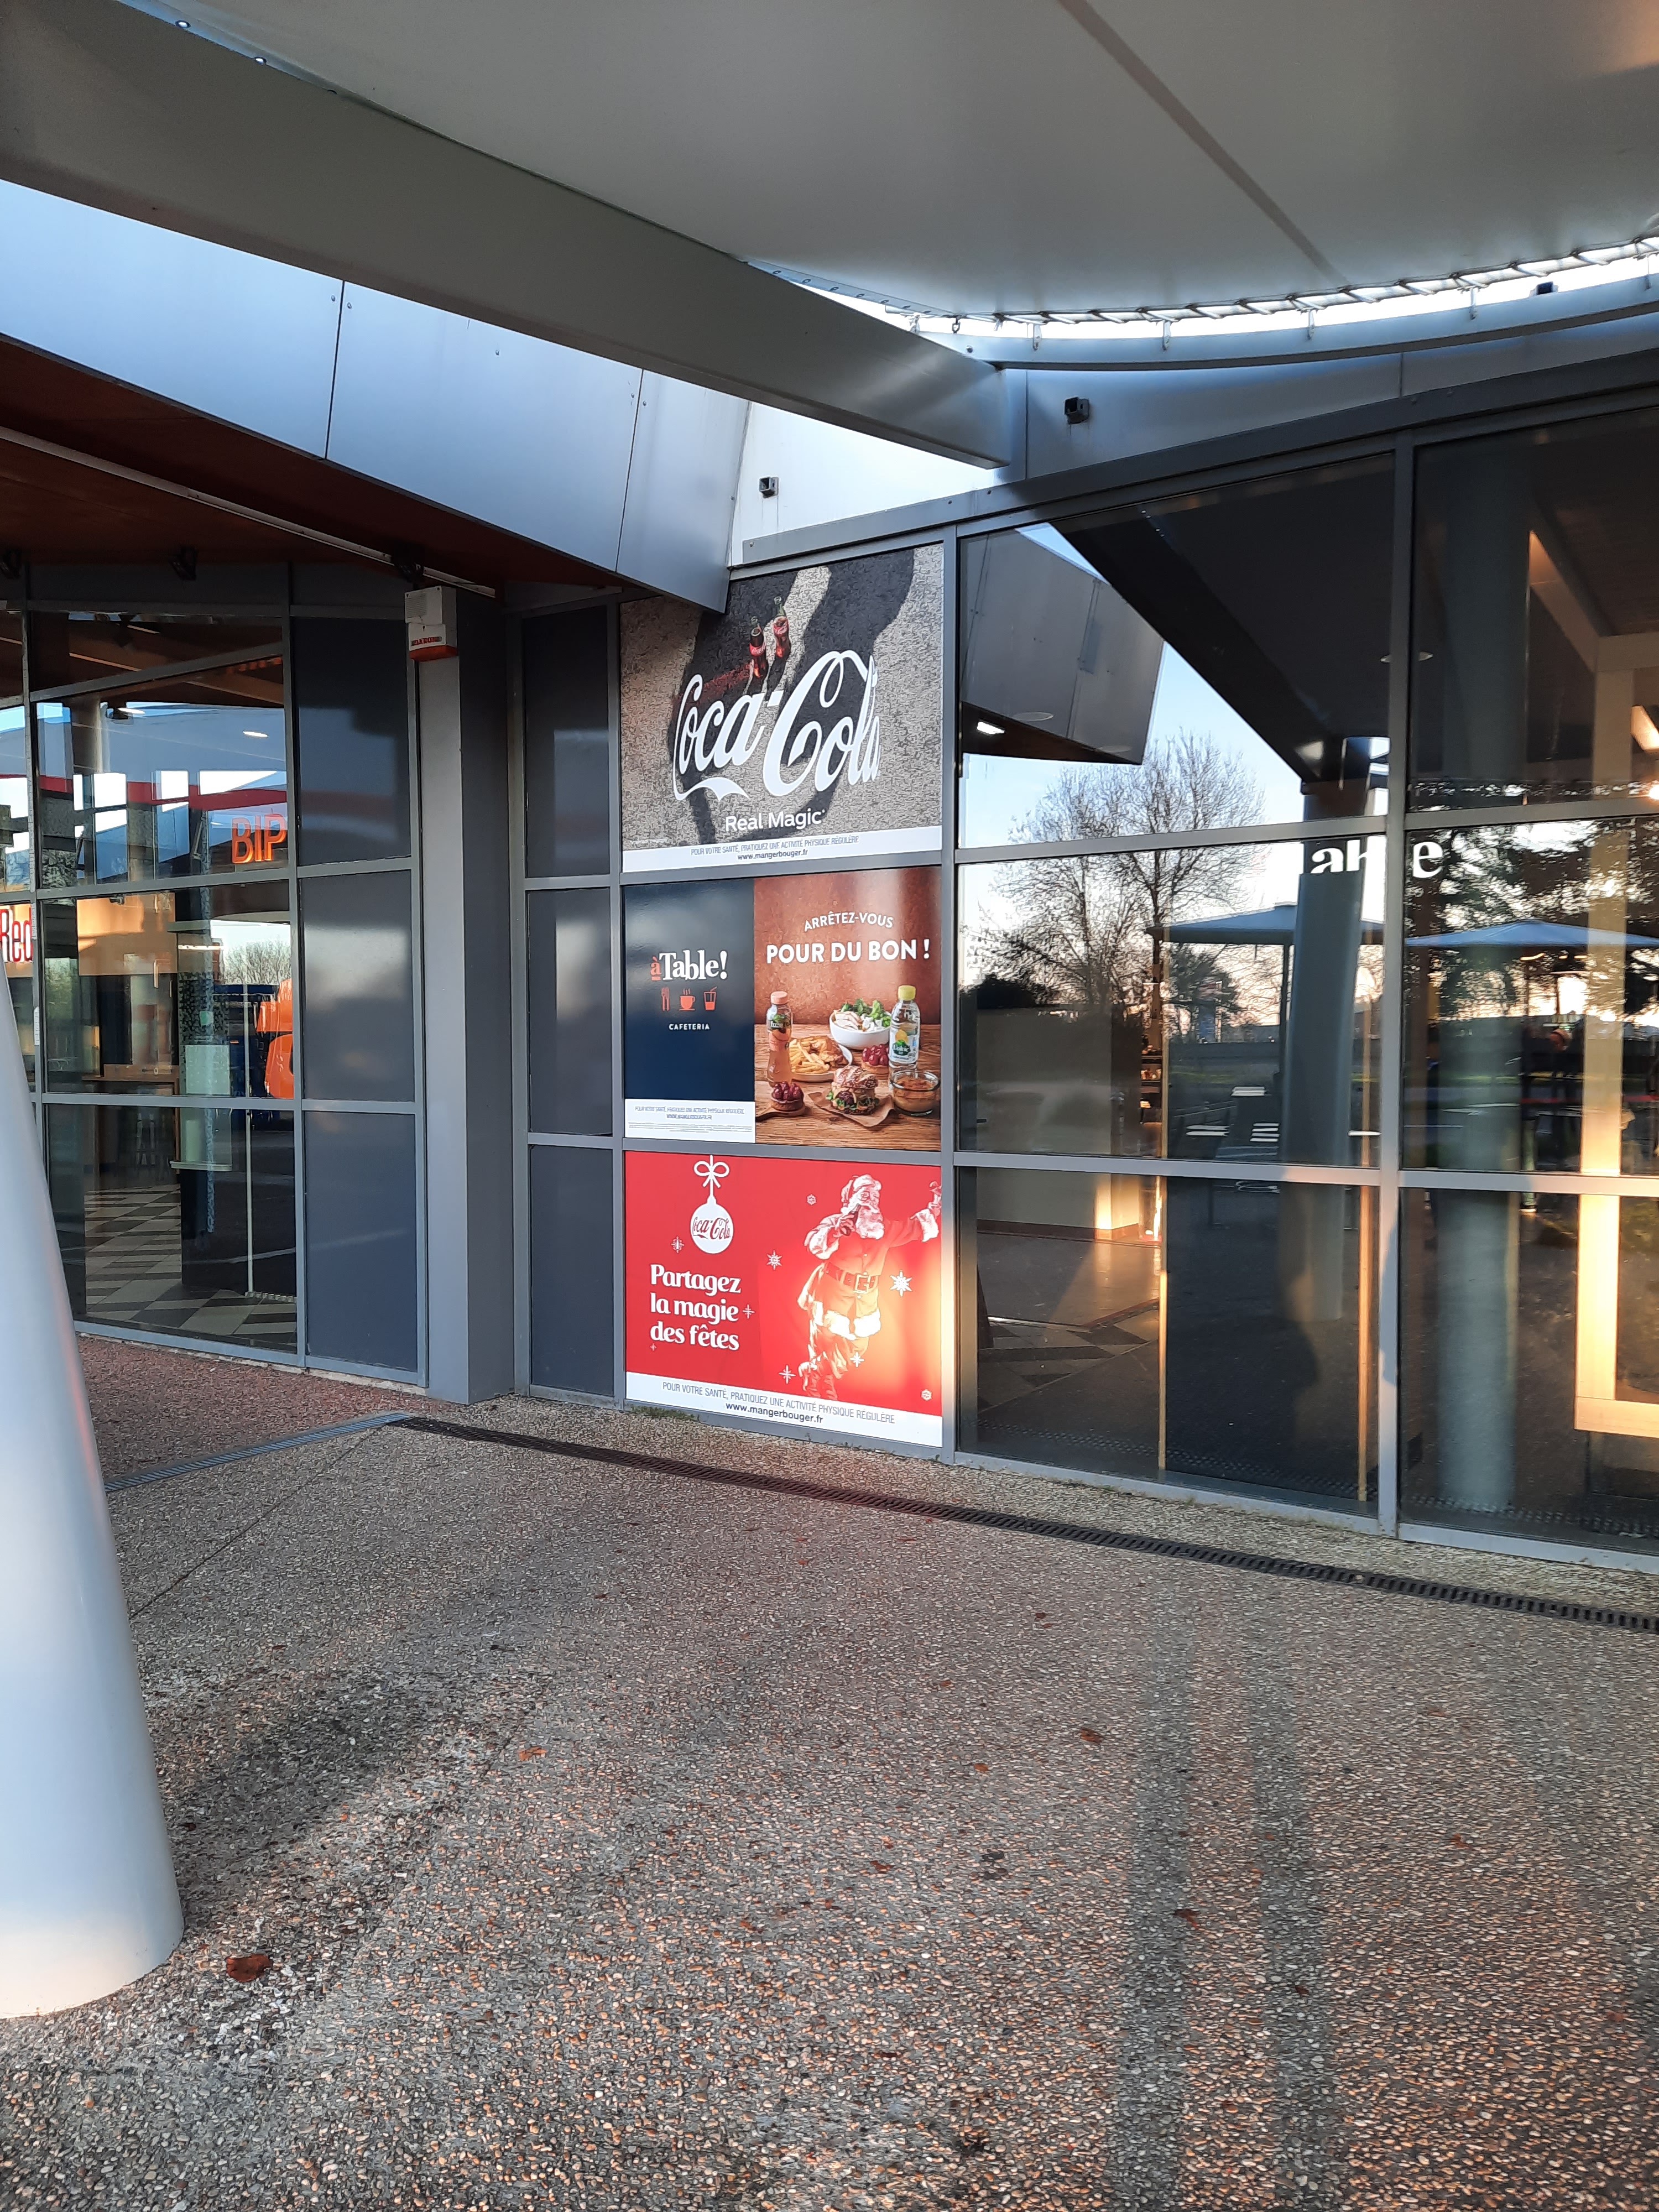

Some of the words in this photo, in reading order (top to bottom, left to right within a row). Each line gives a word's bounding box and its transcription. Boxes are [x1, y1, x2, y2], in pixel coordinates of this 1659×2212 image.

[673, 650, 880, 801] Coca-Cola
[726, 812, 764, 831] Real
[768, 807, 822, 830] Magic
[232, 813, 288, 864] BIP
[804, 911, 894, 932] ARRÊTEZ-VOUS
[766, 943, 825, 964] POUR
[831, 941, 862, 962] DU
[868, 940, 917, 961] BON
[692, 1216, 731, 1240] Coca-Cola
[650, 1264, 742, 1296] Partagez
[650, 1292, 671, 1314] la
[674, 1298, 739, 1325] magie
[650, 1321, 685, 1344] des
[690, 1324, 740, 1351] fêtes
[662, 1382, 681, 1392] POUR
[682, 1384, 703, 1395] VOTRE
[731, 1391, 768, 1405] PRATIQUEZ
[770, 1397, 784, 1407] UNE
[786, 1399, 817, 1412] ACTIVITÉ
[818, 1404, 854, 1418] PHYSIQUE
[726, 1403, 823, 1423] www.mangerbouger.fr
